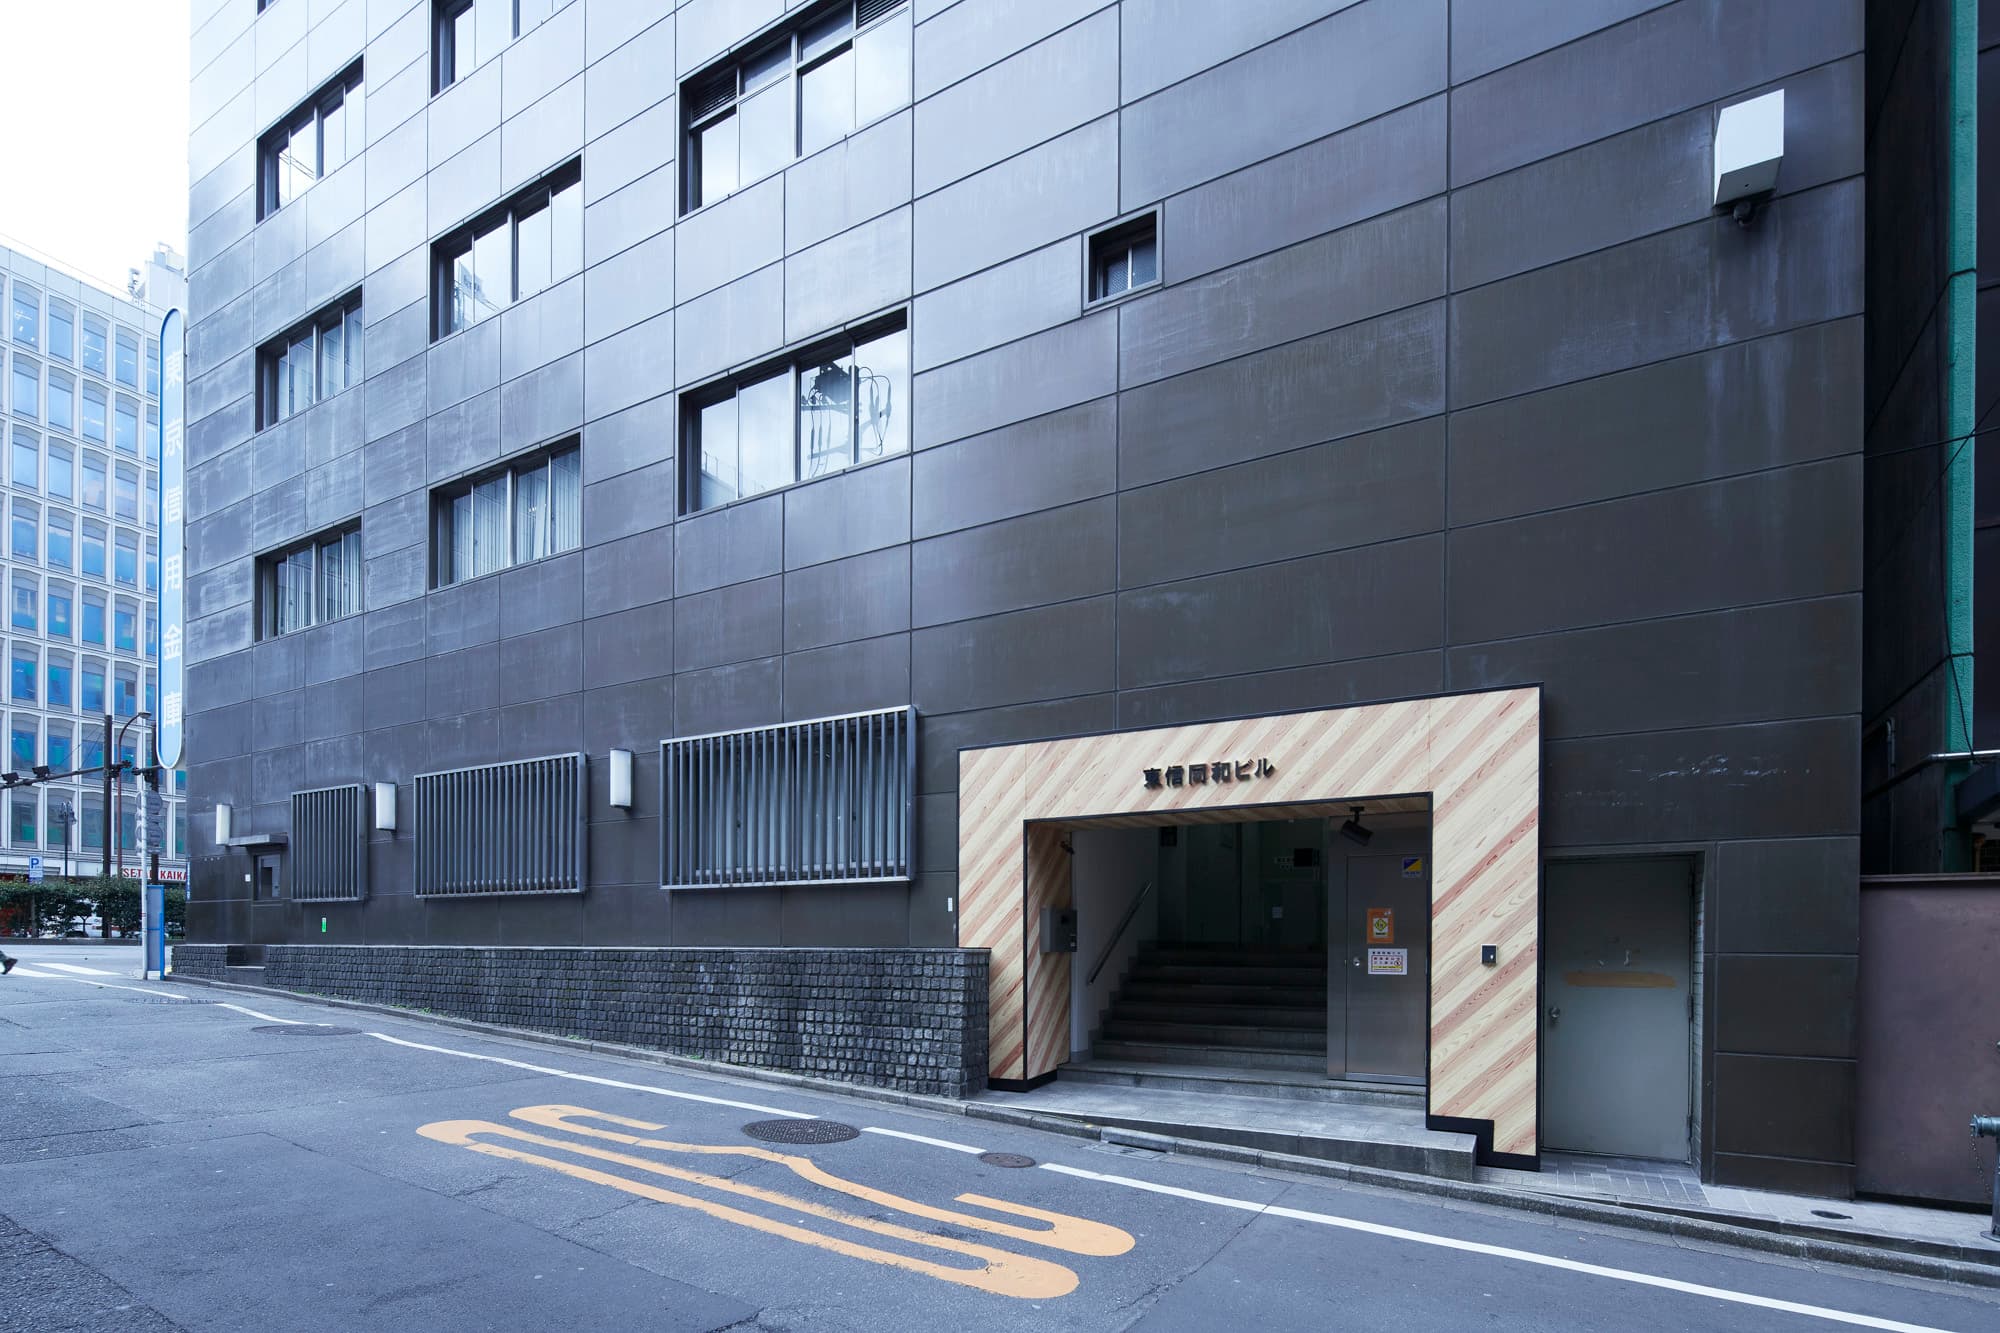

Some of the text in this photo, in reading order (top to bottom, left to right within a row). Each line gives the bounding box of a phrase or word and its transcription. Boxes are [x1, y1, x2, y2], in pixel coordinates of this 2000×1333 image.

[163, 351, 182, 728] 東京信用金庫
[31, 858, 39, 869] P
